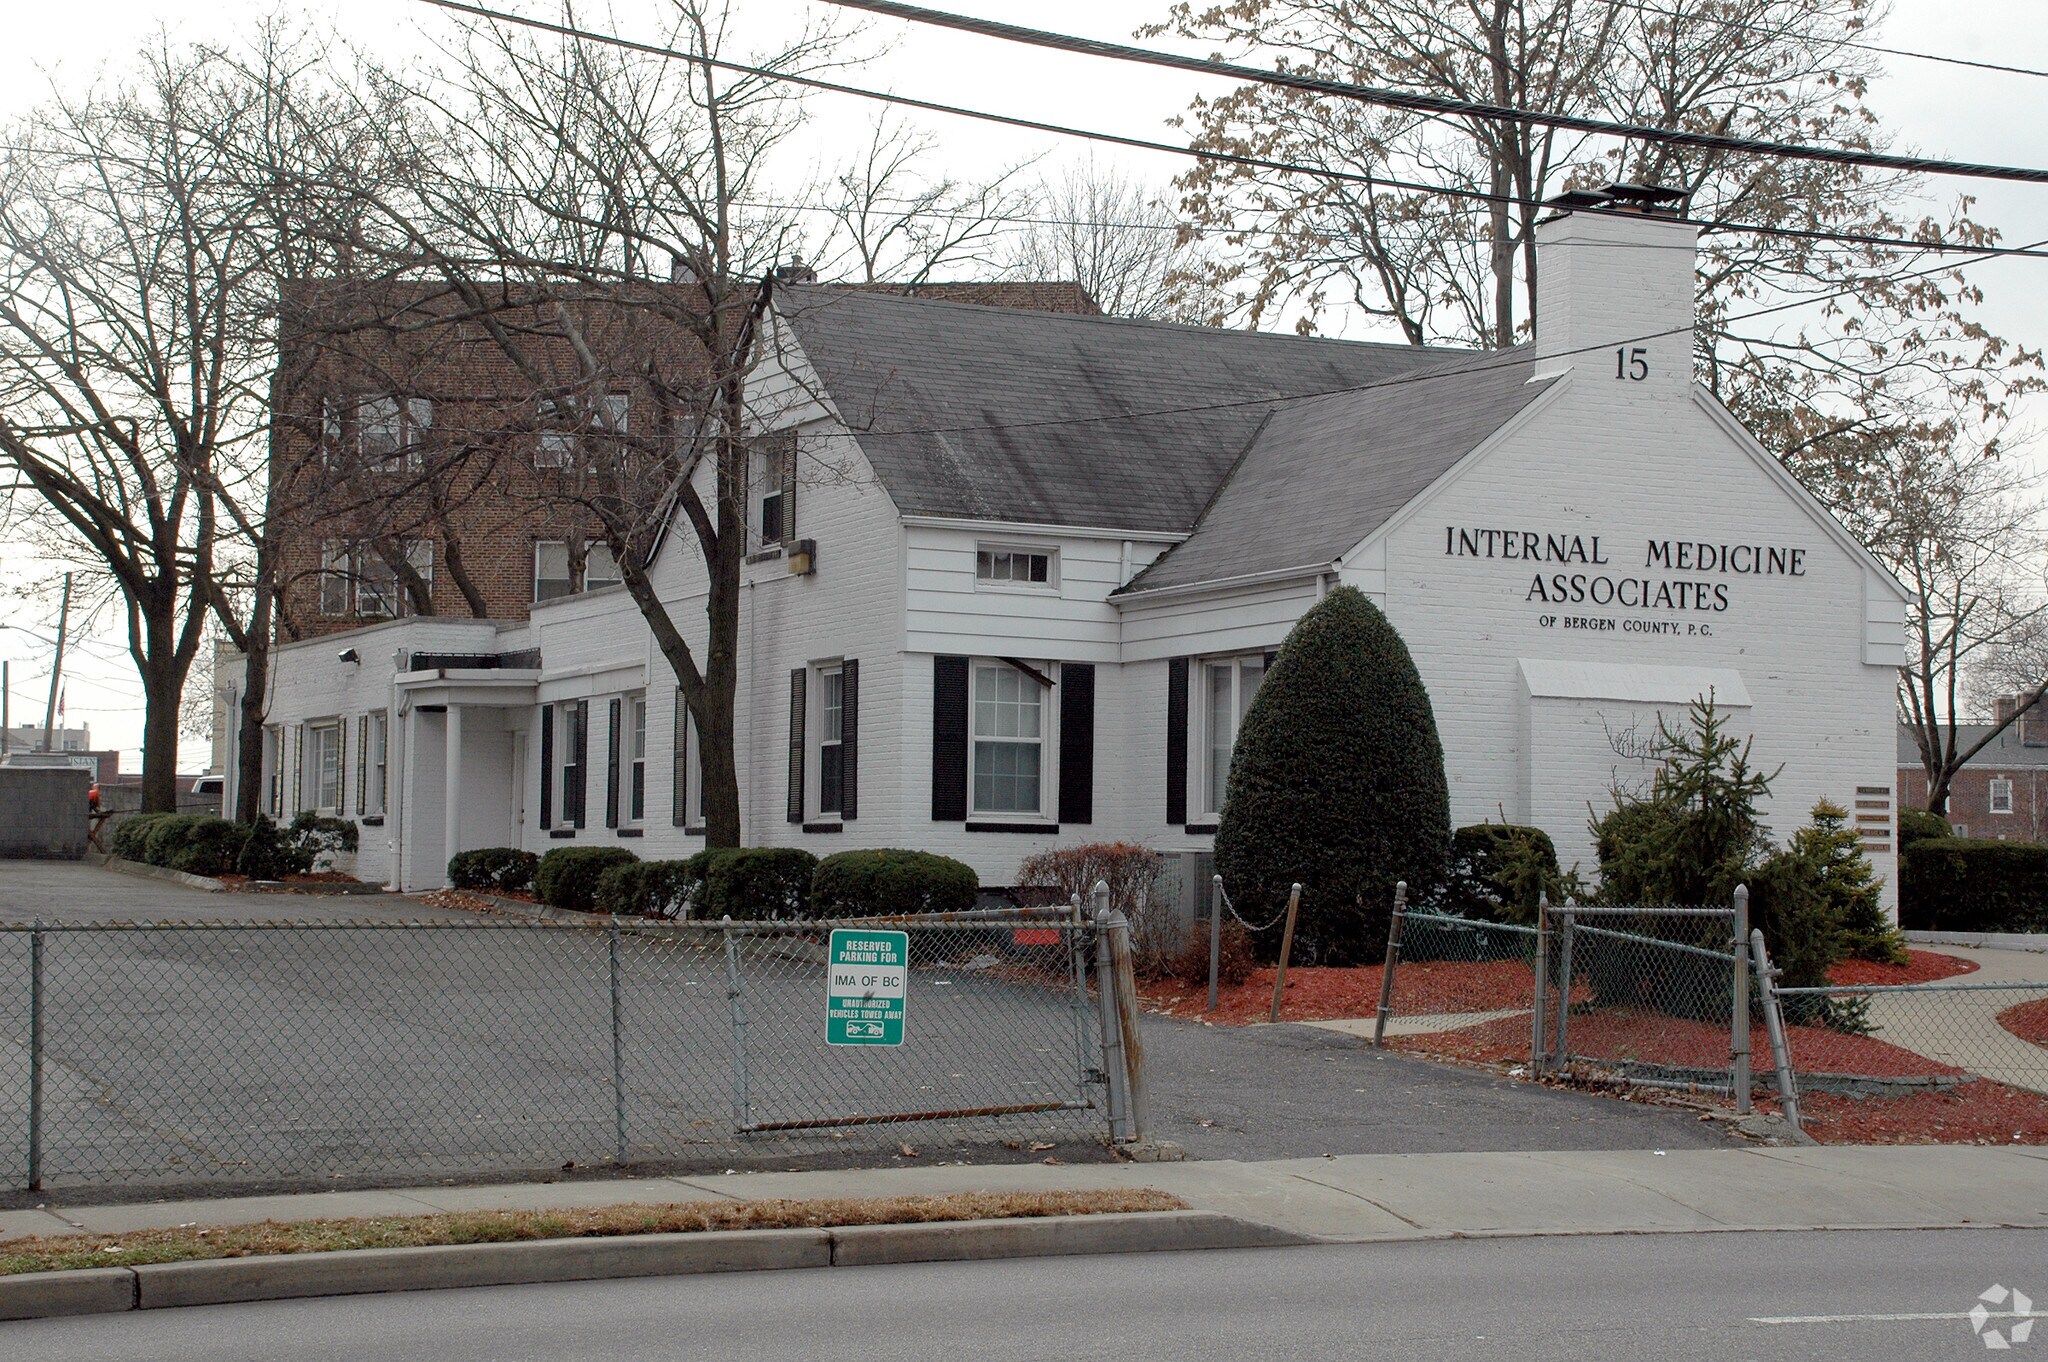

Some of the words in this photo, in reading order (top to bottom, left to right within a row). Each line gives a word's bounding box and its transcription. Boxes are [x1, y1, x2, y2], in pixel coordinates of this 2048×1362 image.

[1616, 347, 1648, 380] 15
[1445, 526, 1609, 564] INTERNAL
[1645, 540, 1806, 576] MEDICINE
[1526, 574, 1729, 612] ASSOCIATES
[1539, 615, 1557, 628] OF
[1564, 616, 1616, 631] BERGEN
[1623, 619, 1680, 636] COUNTY,
[846, 940, 892, 951] RESERVED
[840, 952, 877, 962] PARKING
[881, 952, 897, 963] FOR
[835, 975, 856, 986] IMA
[862, 976, 878, 987] OF
[883, 976, 900, 988] BC
[830, 1009, 859, 1018] VEHICLES
[861, 1010, 882, 1019] TOWED
[884, 1010, 902, 1020] AWAY
